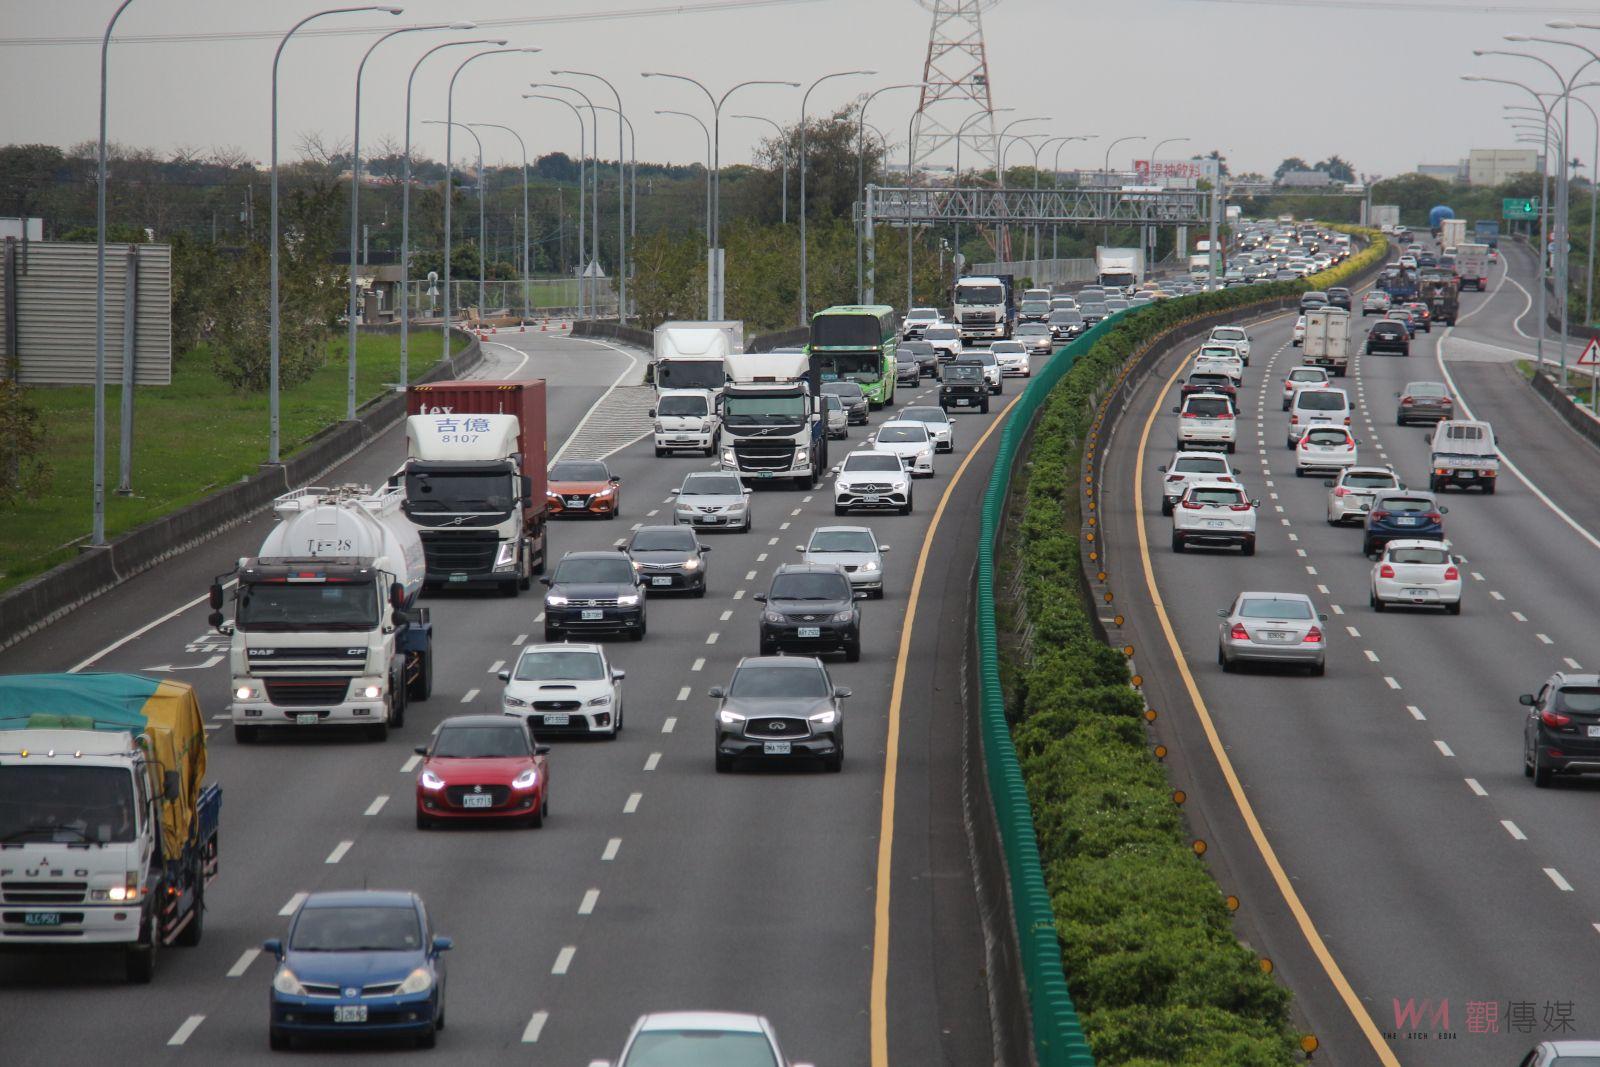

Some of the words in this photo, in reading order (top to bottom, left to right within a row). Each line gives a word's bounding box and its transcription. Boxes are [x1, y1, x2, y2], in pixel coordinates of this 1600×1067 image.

[435, 418, 491, 433] 吉億
[442, 434, 480, 443] 8107
[1, 869, 89, 877] FUSO
